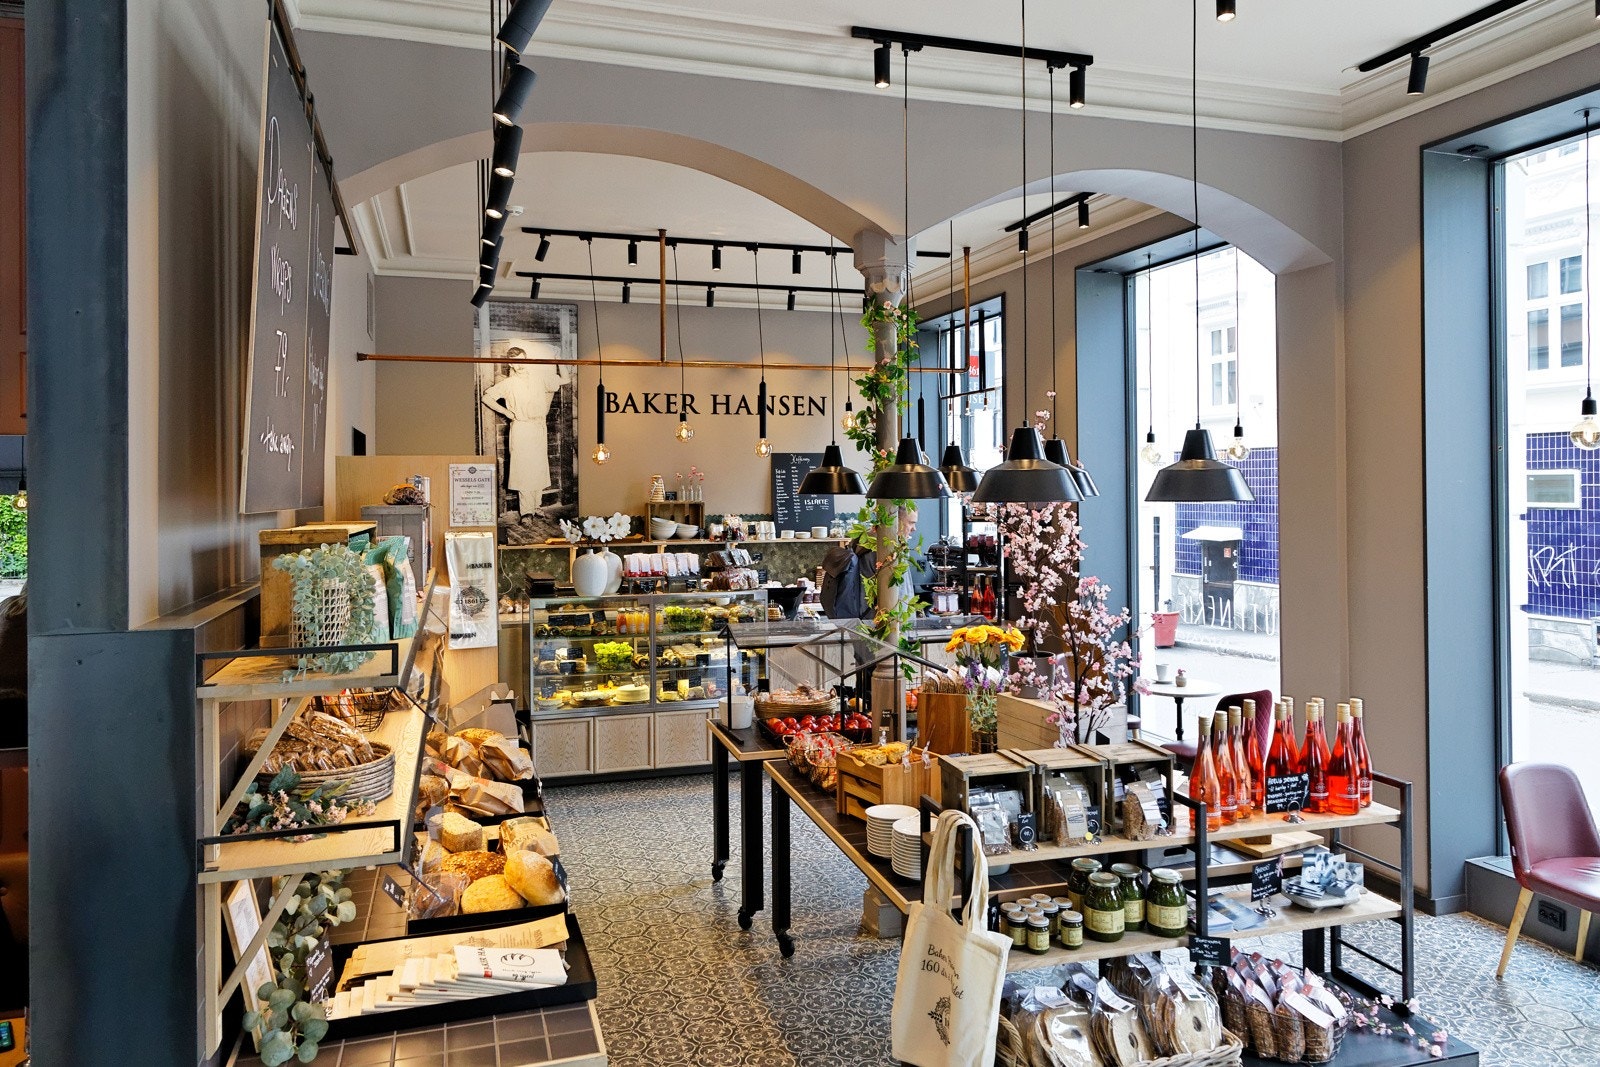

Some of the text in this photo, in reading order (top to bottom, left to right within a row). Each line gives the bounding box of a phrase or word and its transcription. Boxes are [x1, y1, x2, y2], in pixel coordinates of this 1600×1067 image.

[605, 392, 827, 416] BAKER HANSEN
[921, 959, 940, 973] 160
